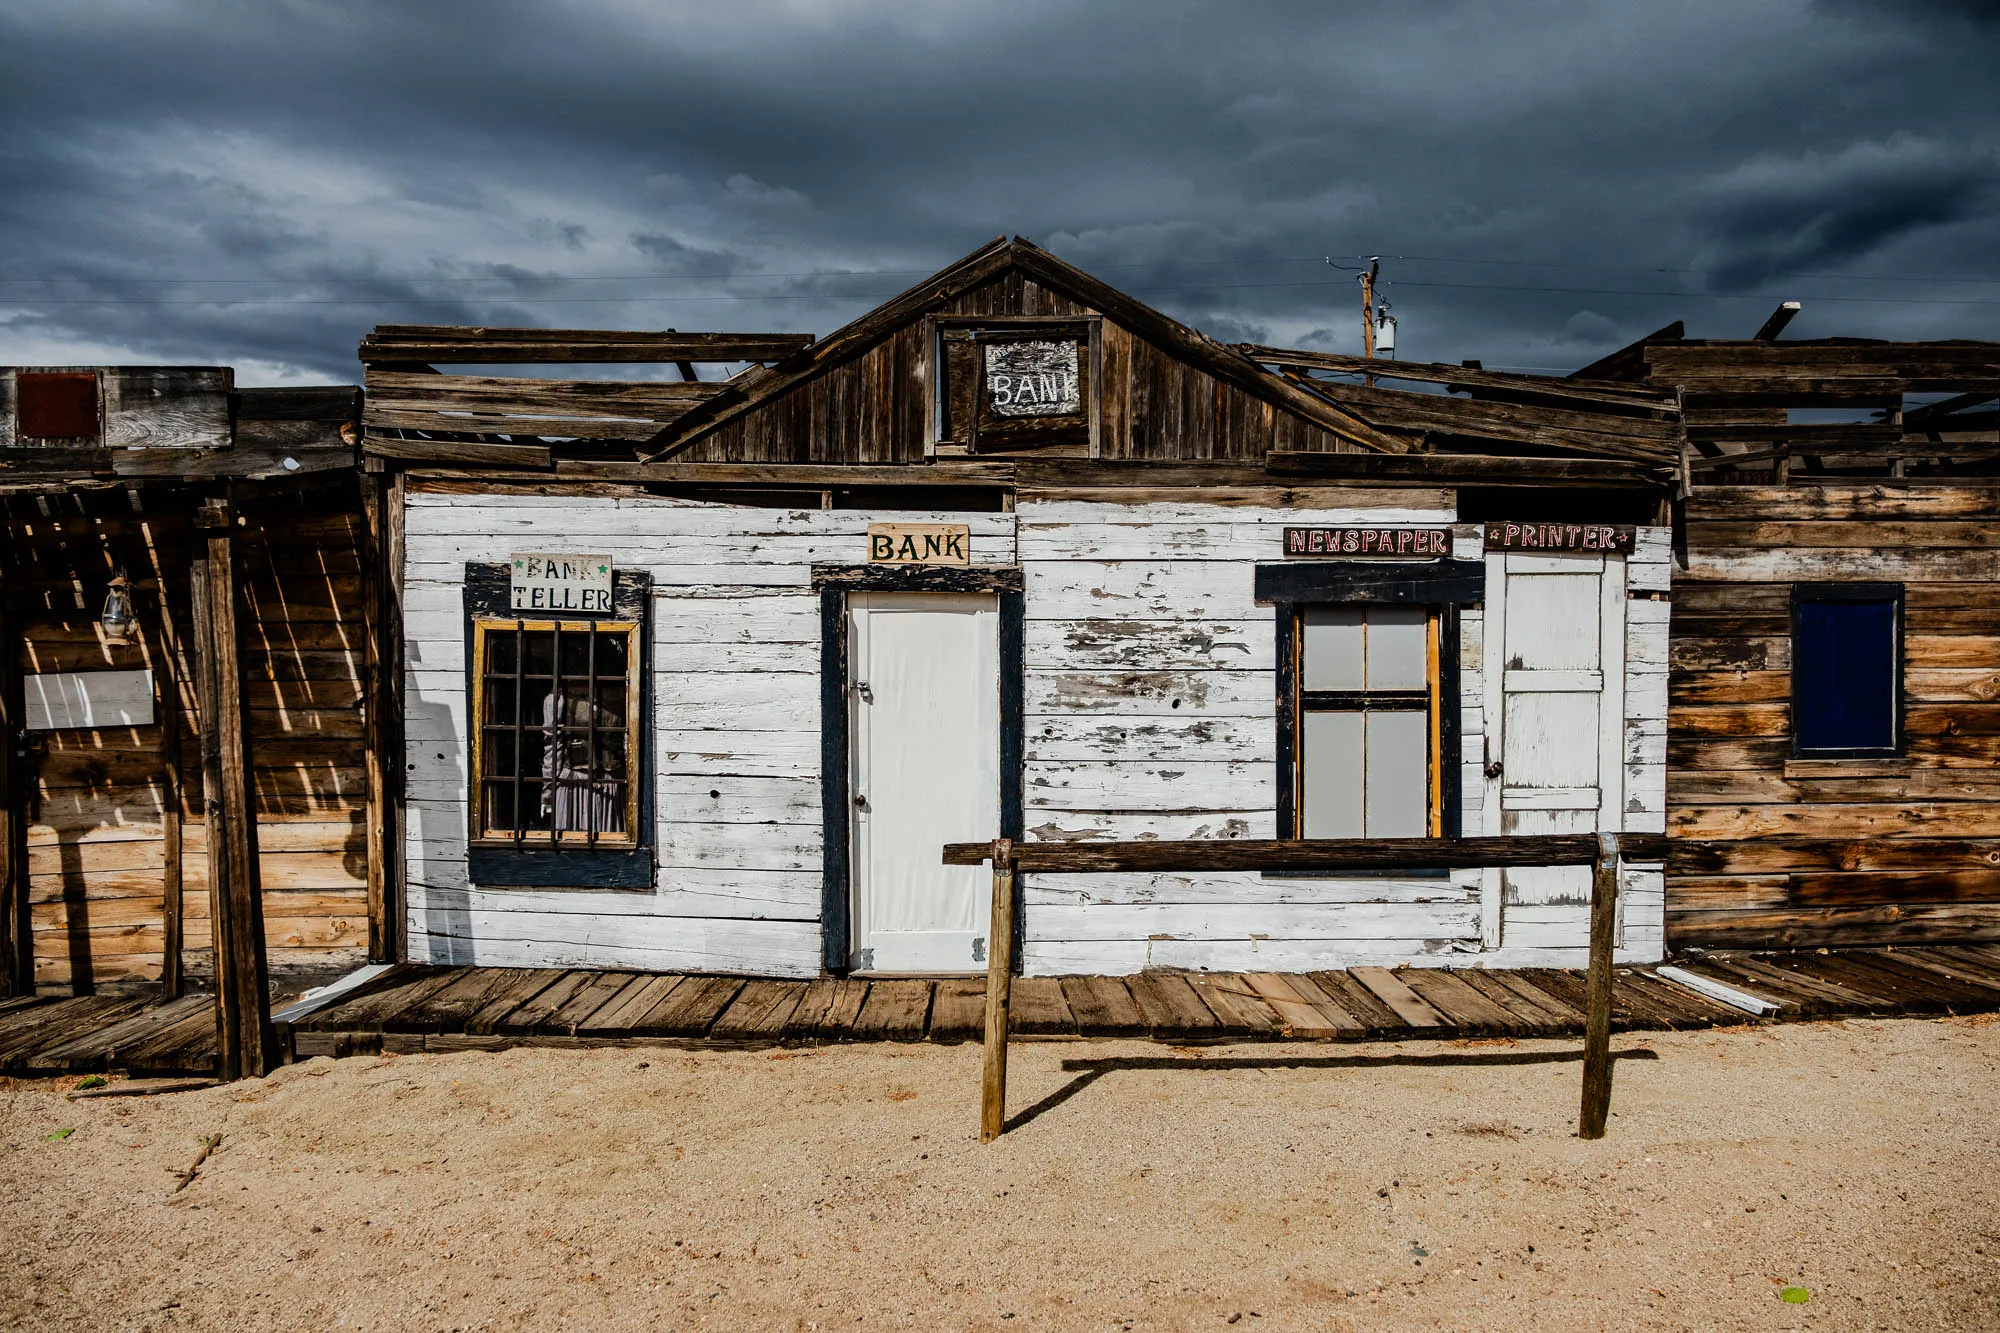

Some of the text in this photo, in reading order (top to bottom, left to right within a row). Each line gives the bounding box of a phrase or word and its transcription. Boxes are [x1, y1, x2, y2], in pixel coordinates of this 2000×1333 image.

[871, 534, 966, 561] BANK
[1290, 530, 1447, 553] NEWSPAPER
[1503, 524, 1616, 549] PRINTER
[513, 586, 611, 611] TELLER
